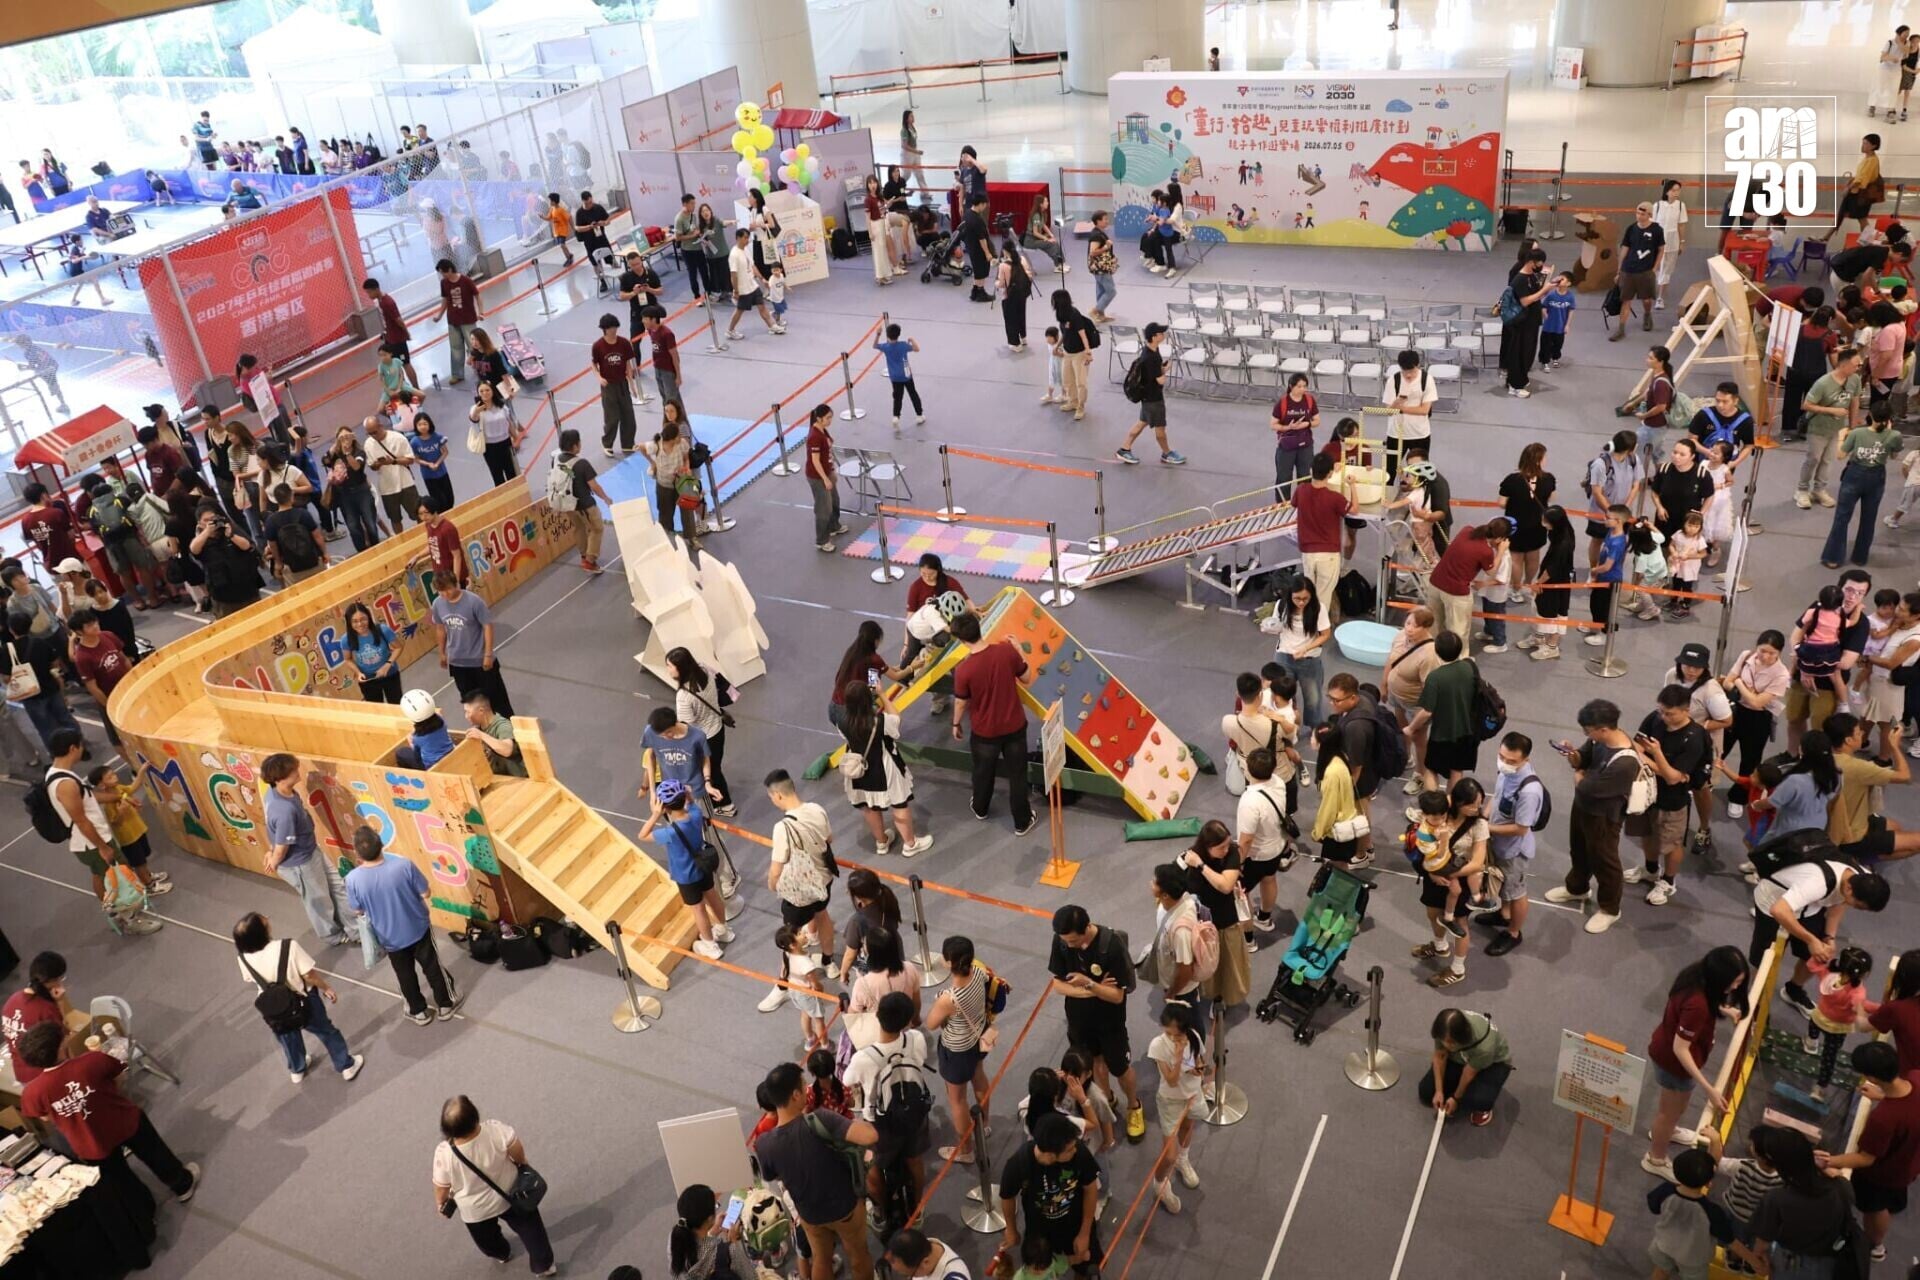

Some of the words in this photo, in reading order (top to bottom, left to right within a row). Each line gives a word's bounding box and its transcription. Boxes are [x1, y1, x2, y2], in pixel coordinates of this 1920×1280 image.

[1326, 92, 1355, 100] 2030
[1265, 103, 1297, 112] Playground
[1319, 104, 1339, 112] Project
[1304, 141, 1343, 150] 2026.07.05
[663, 752, 688, 762] YMCA
